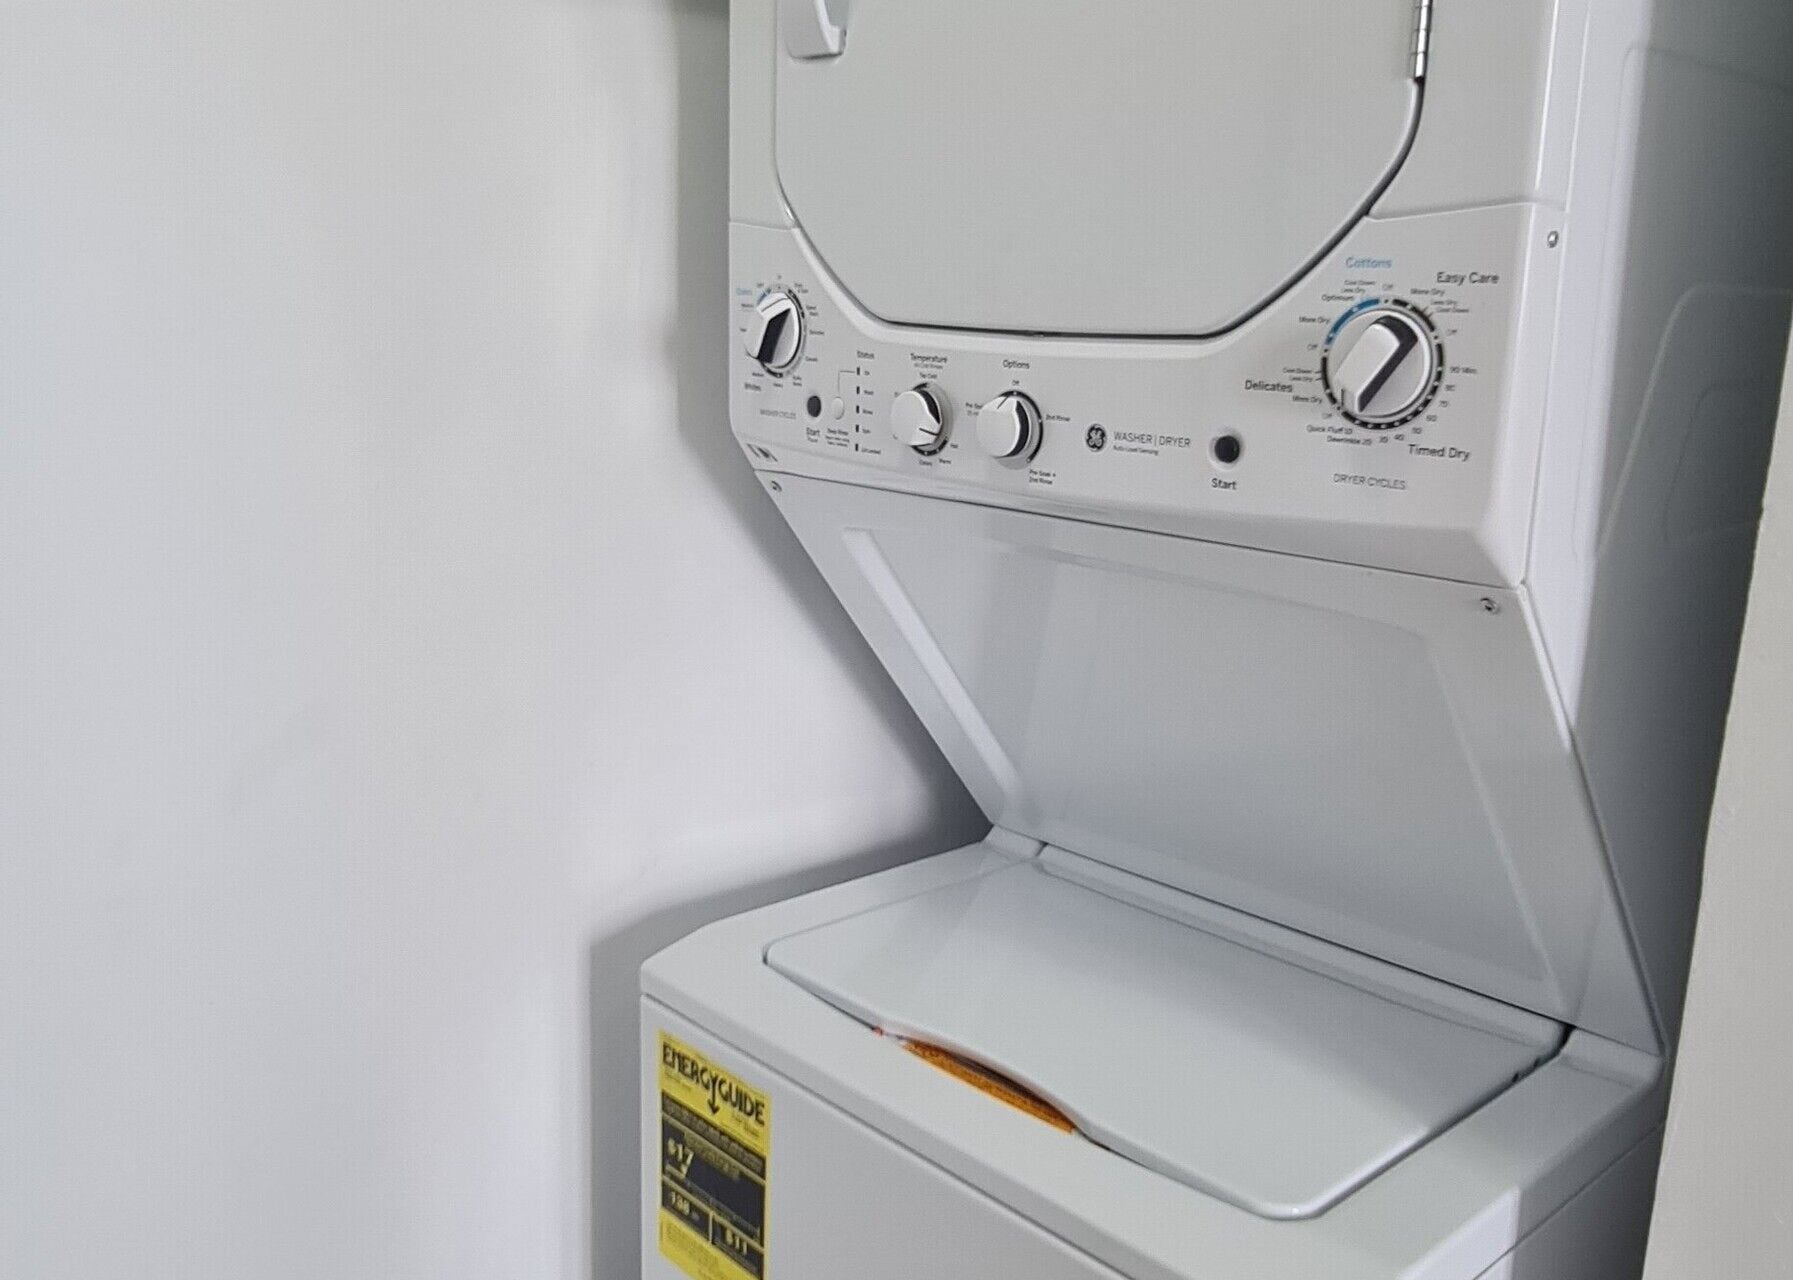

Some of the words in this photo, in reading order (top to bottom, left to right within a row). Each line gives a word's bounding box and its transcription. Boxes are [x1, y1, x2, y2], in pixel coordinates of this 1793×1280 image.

[1345, 257, 1393, 269] Cottons
[1436, 271, 1466, 286] Easy
[1468, 272, 1500, 284] Care
[1002, 359, 1031, 371] Options
[1244, 380, 1294, 394] Delicates
[1113, 431, 1152, 445] WASHER
[1159, 435, 1191, 448] DRYER
[1408, 443, 1445, 458] Timed
[1449, 447, 1471, 462] Dry
[1211, 477, 1237, 491] Start
[1333, 472, 1366, 486] DRYER
[1367, 476, 1407, 491] CYCLES
